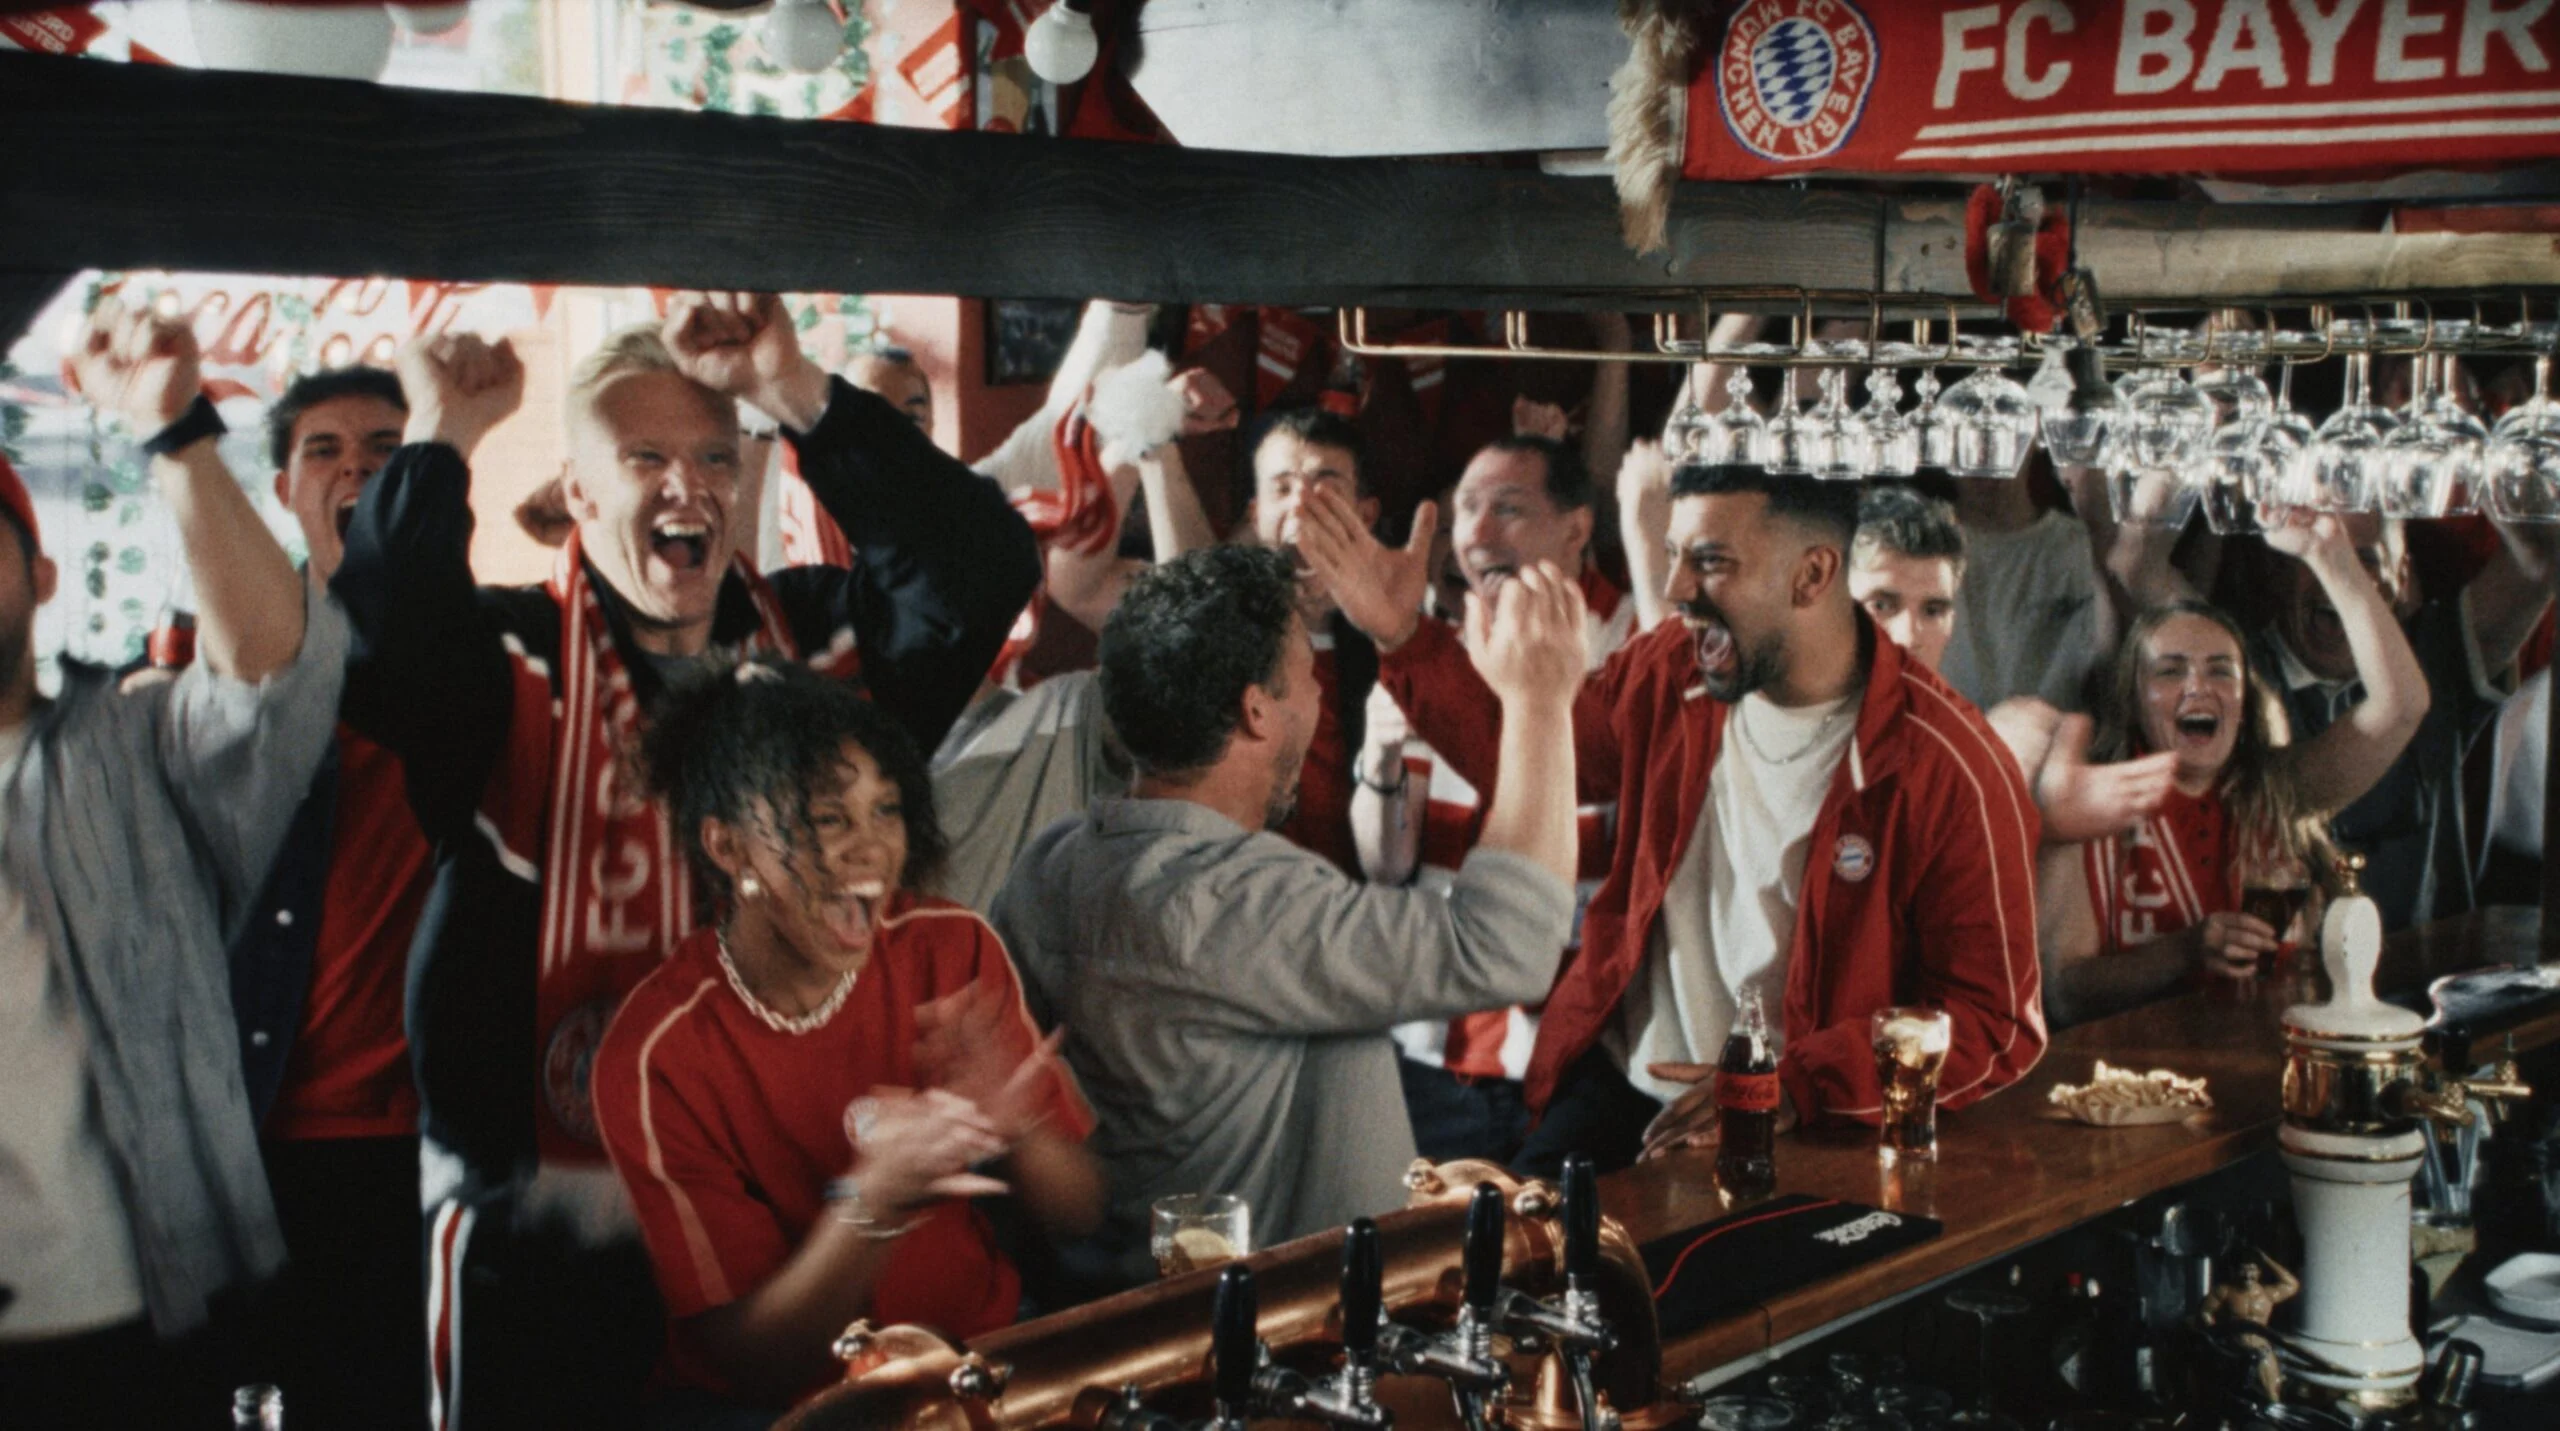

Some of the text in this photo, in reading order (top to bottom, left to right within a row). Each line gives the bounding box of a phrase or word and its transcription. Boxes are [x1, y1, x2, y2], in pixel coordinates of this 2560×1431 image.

[1793, 0, 1864, 155] FC BAYERN
[1932, 0, 2556, 110] FC BAYER
[2120, 867, 2171, 945] FC
